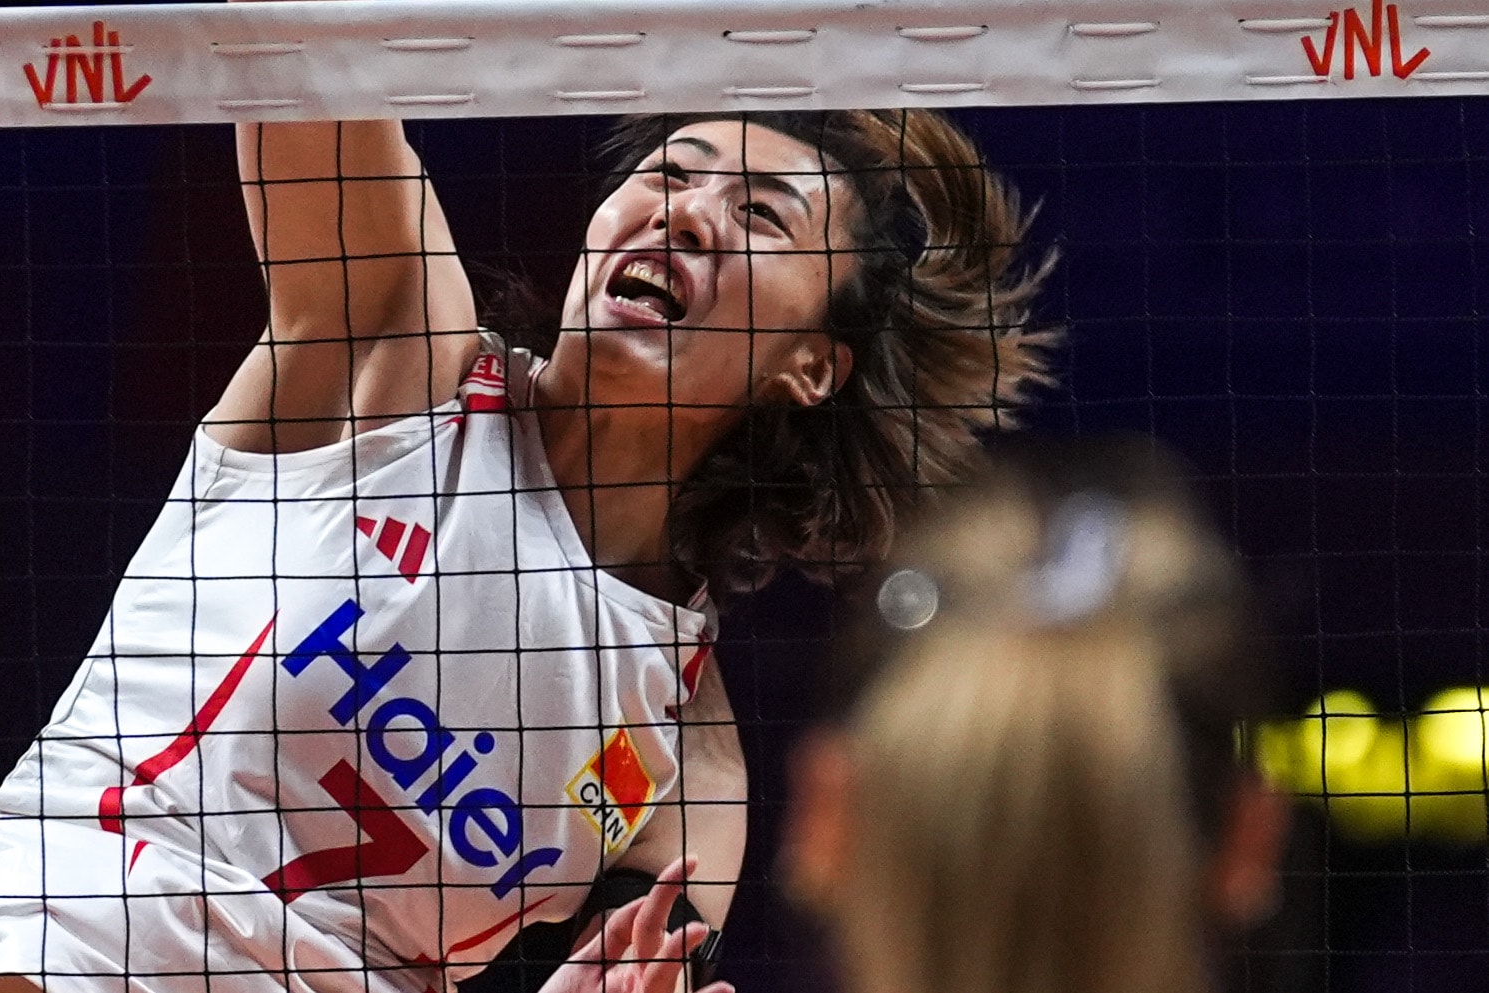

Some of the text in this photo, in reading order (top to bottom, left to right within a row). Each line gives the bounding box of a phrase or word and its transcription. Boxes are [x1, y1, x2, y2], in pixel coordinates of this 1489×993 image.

[23, 21, 153, 109] VNL
[280, 598, 564, 900] Haier
[261, 758, 429, 904] 7
[580, 782, 624, 842] CHN
